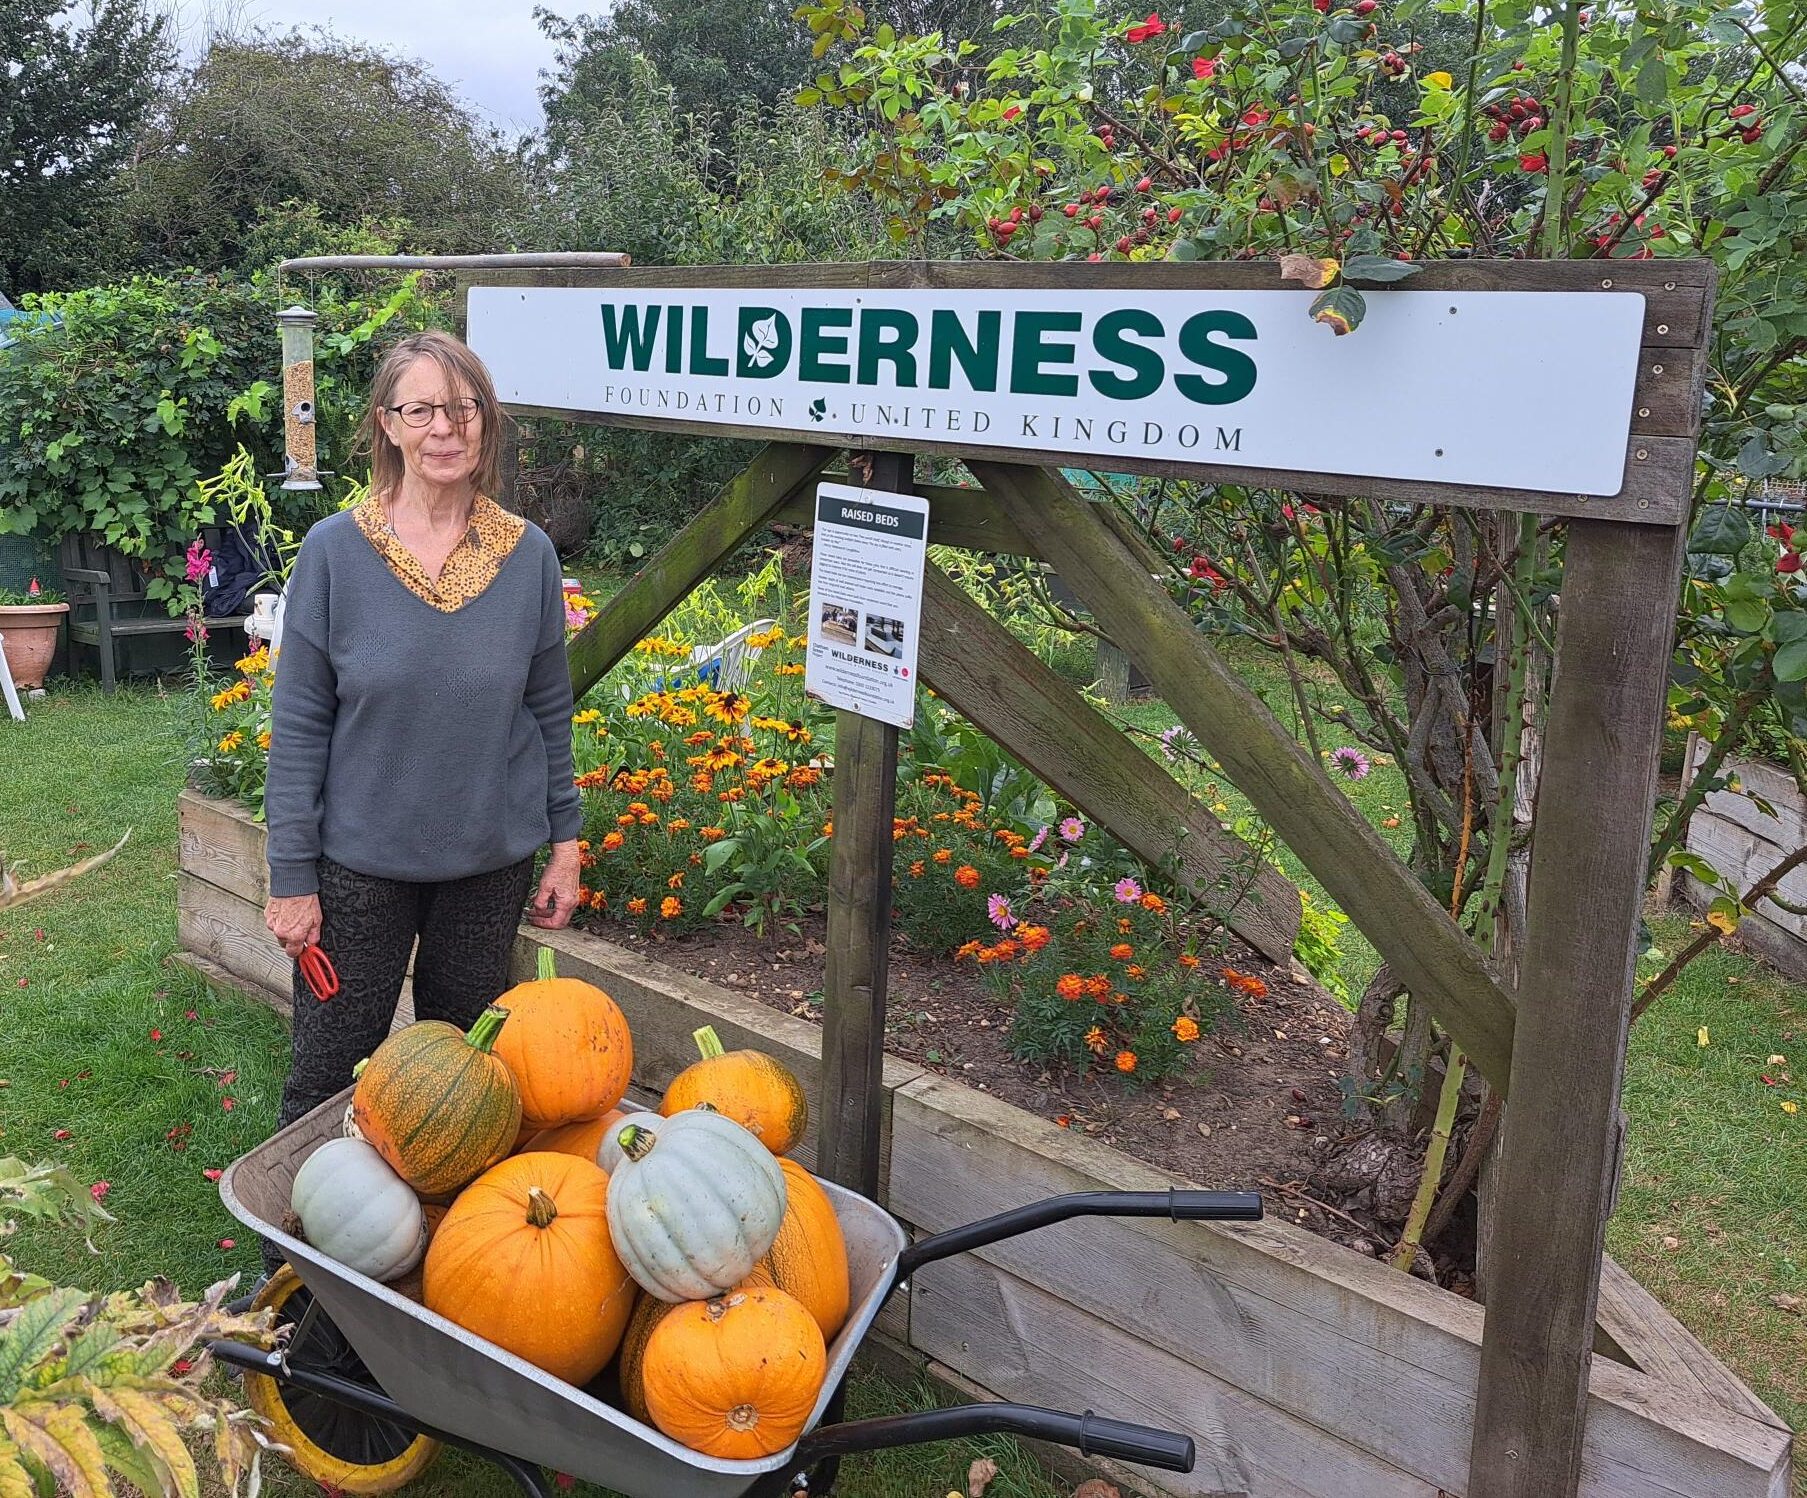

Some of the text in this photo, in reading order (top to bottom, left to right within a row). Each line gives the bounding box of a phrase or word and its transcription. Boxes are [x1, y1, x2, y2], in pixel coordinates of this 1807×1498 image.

[600, 304, 1258, 406] WILDERNESS
[604, 386, 1244, 452] FOUNDATION UNITED KINGDOM
[841, 507, 899, 527] RAISED BEDS
[831, 649, 889, 672] WILDERNESS
